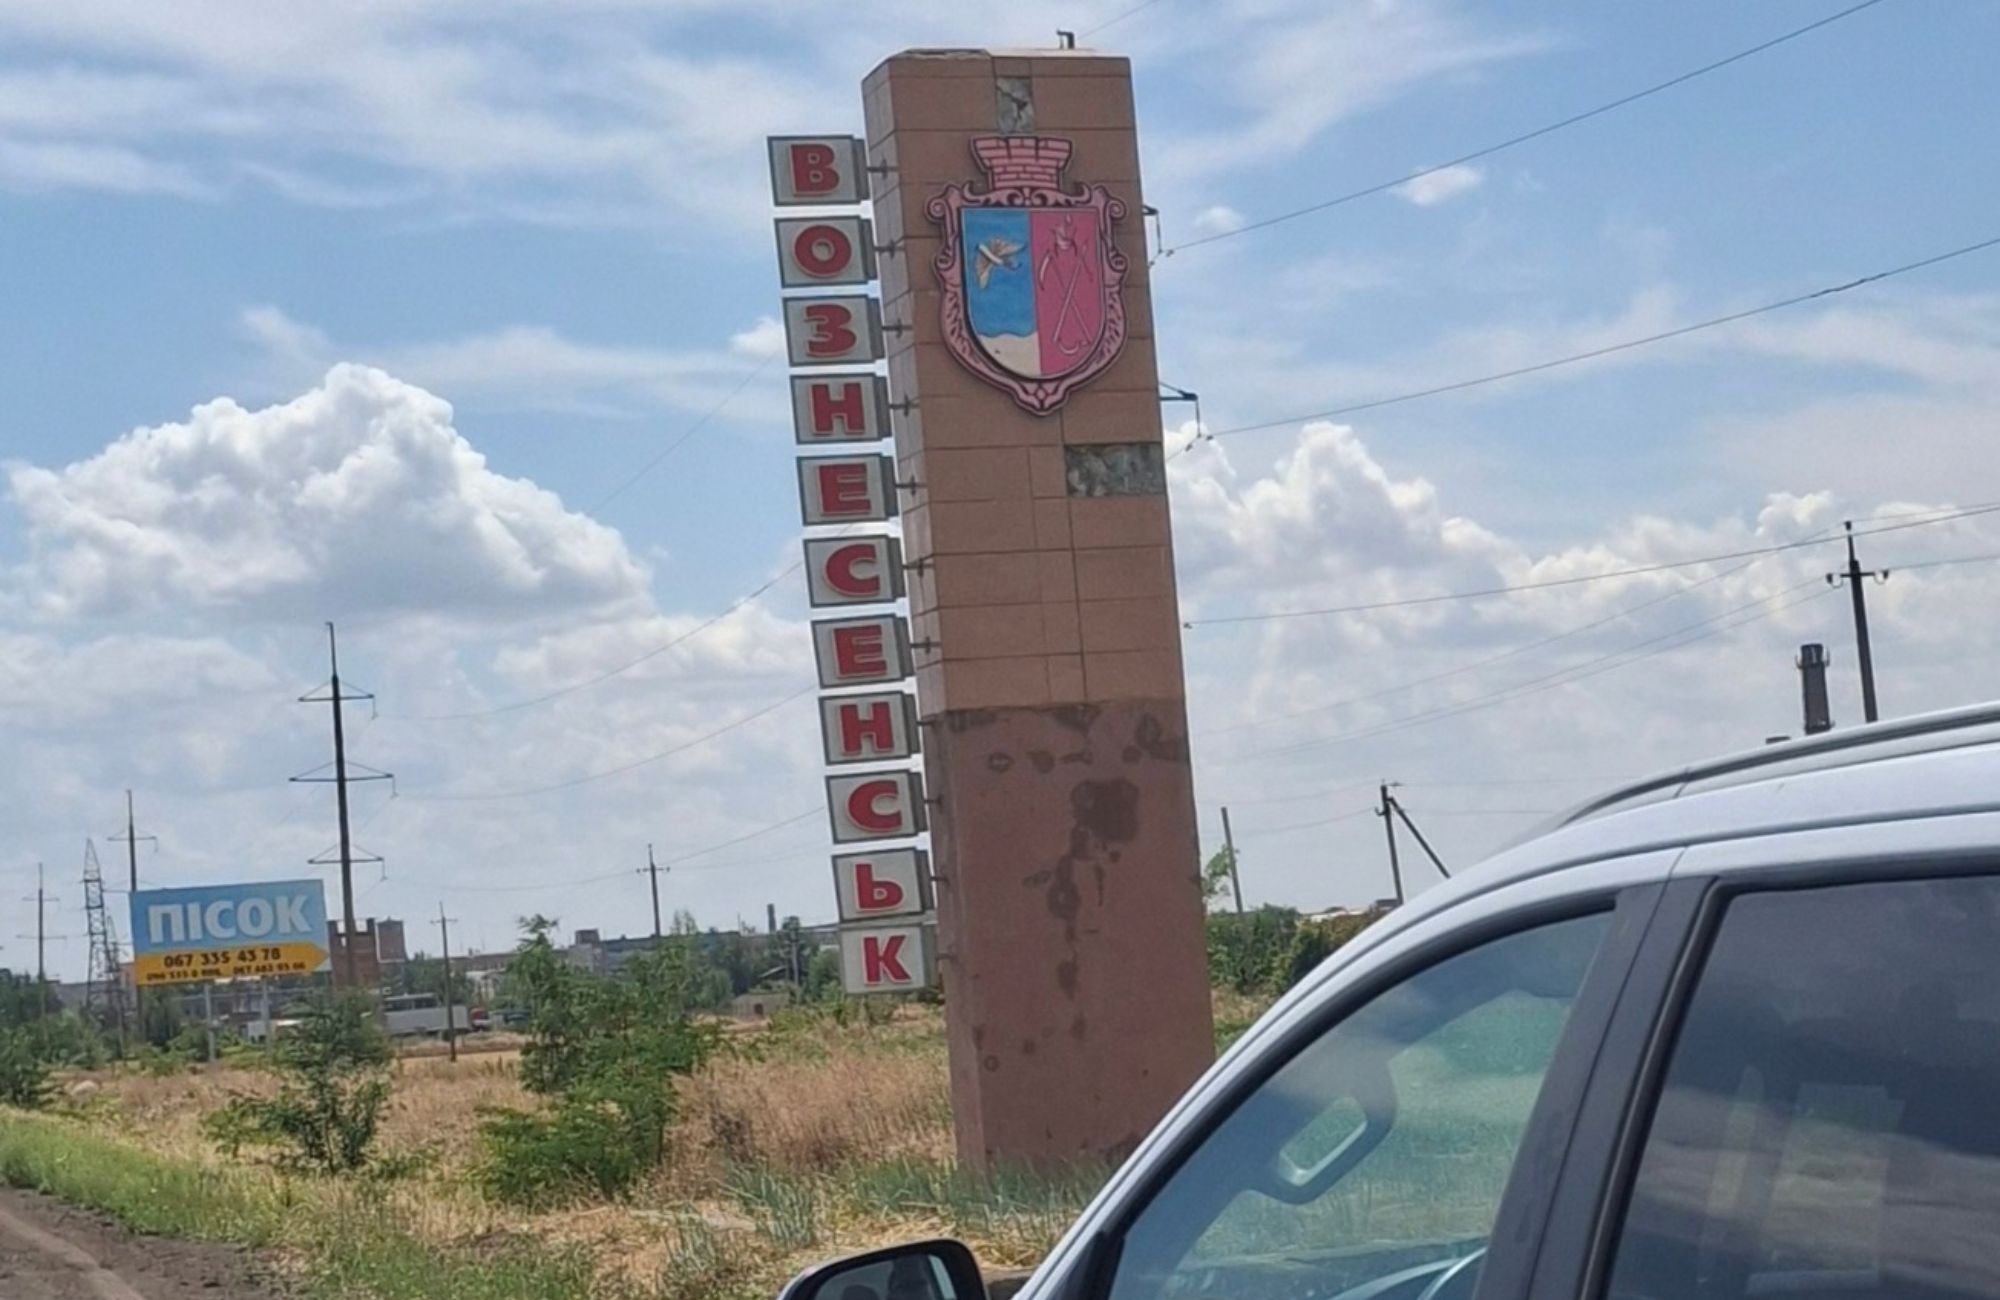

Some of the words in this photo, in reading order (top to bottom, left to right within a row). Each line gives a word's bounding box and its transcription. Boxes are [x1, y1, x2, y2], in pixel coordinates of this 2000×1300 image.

[789, 142, 913, 987] ВОЗНЕСЕНСЬК
[147, 894, 312, 944] ПІСОК
[164, 953, 194, 969] 067
[201, 951, 230, 966] 335
[237, 949, 257, 963] 43
[263, 947, 281, 961] 78
